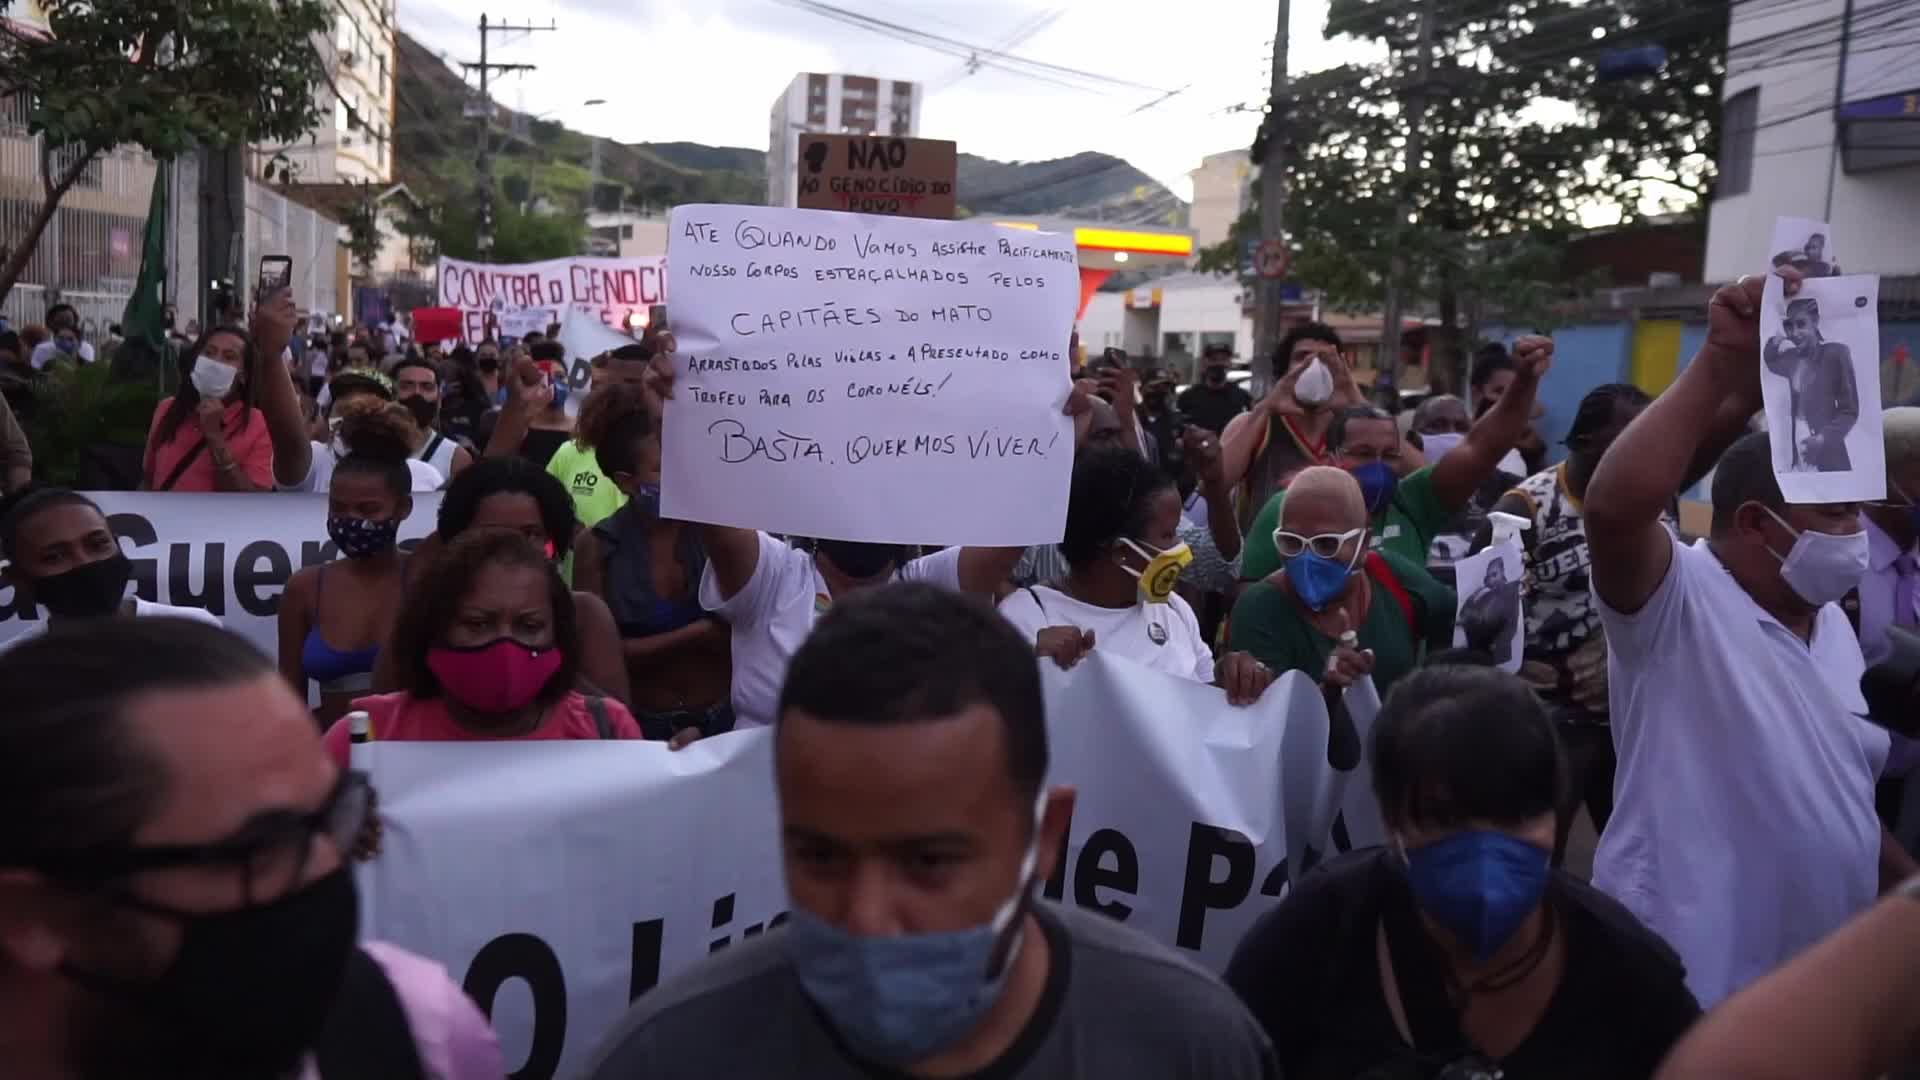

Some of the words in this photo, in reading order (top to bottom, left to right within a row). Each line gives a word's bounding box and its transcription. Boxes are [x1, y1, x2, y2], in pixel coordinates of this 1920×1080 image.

[735, 219, 837, 252] QUANDO
[443, 265, 545, 307] CONTRA
[689, 263, 737, 278] NOSSO
[815, 267, 969, 285] ESTRAÇALHADOS
[986, 271, 1046, 289] PELOS
[730, 301, 882, 337] CAPITÃES
[895, 308, 920, 323] DO
[931, 304, 993, 323] MATO
[1019, 350, 1061, 361] COMO
[688, 386, 746, 406] TROFEU
[758, 388, 792, 407] PARA
[806, 388, 826, 404] OS
